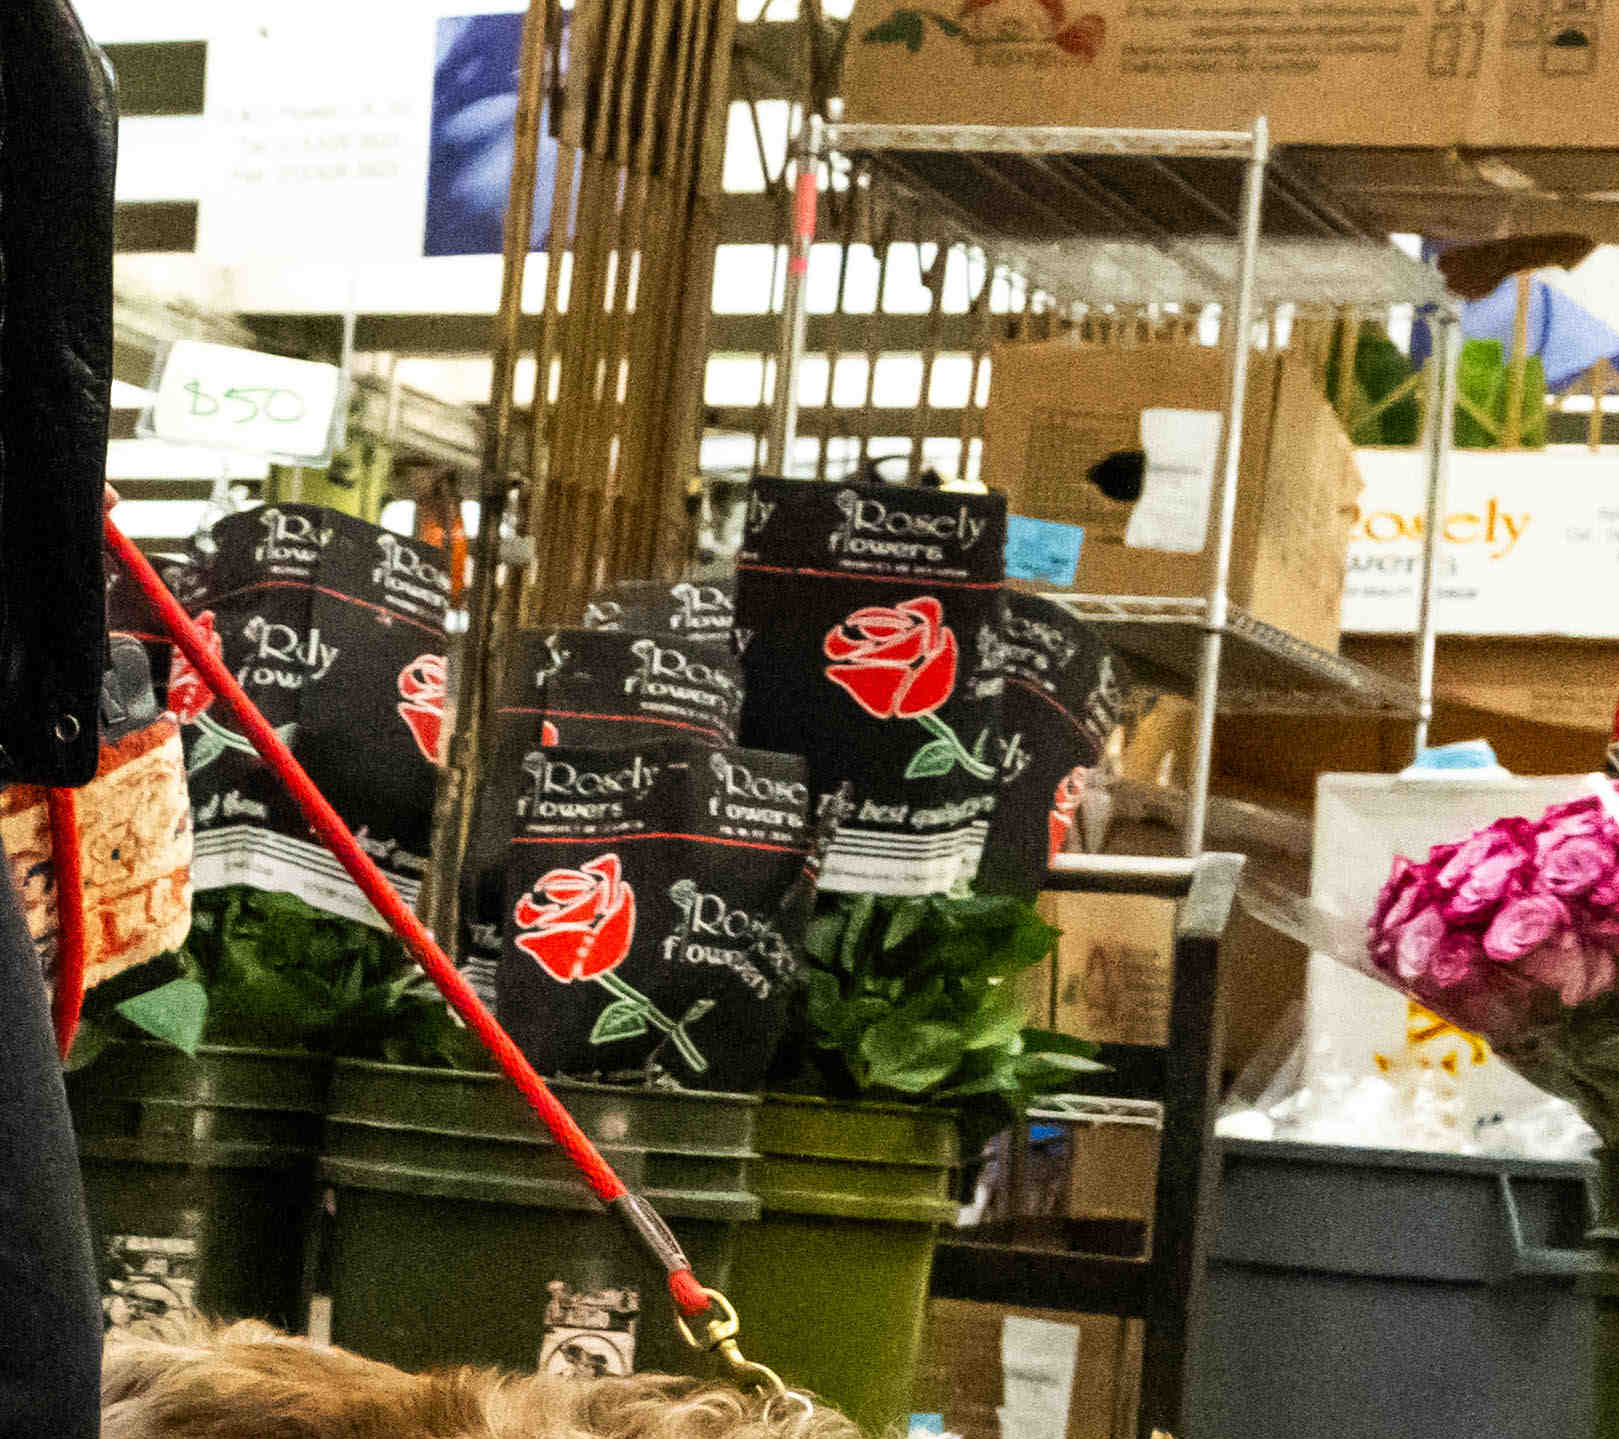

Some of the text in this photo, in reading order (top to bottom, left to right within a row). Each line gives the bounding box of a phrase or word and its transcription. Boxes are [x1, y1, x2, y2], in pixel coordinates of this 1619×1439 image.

[183, 379, 306, 424] $50
[854, 498, 989, 552] Rosely
[543, 756, 660, 802] Rosely
[726, 763, 808, 806] Rose
